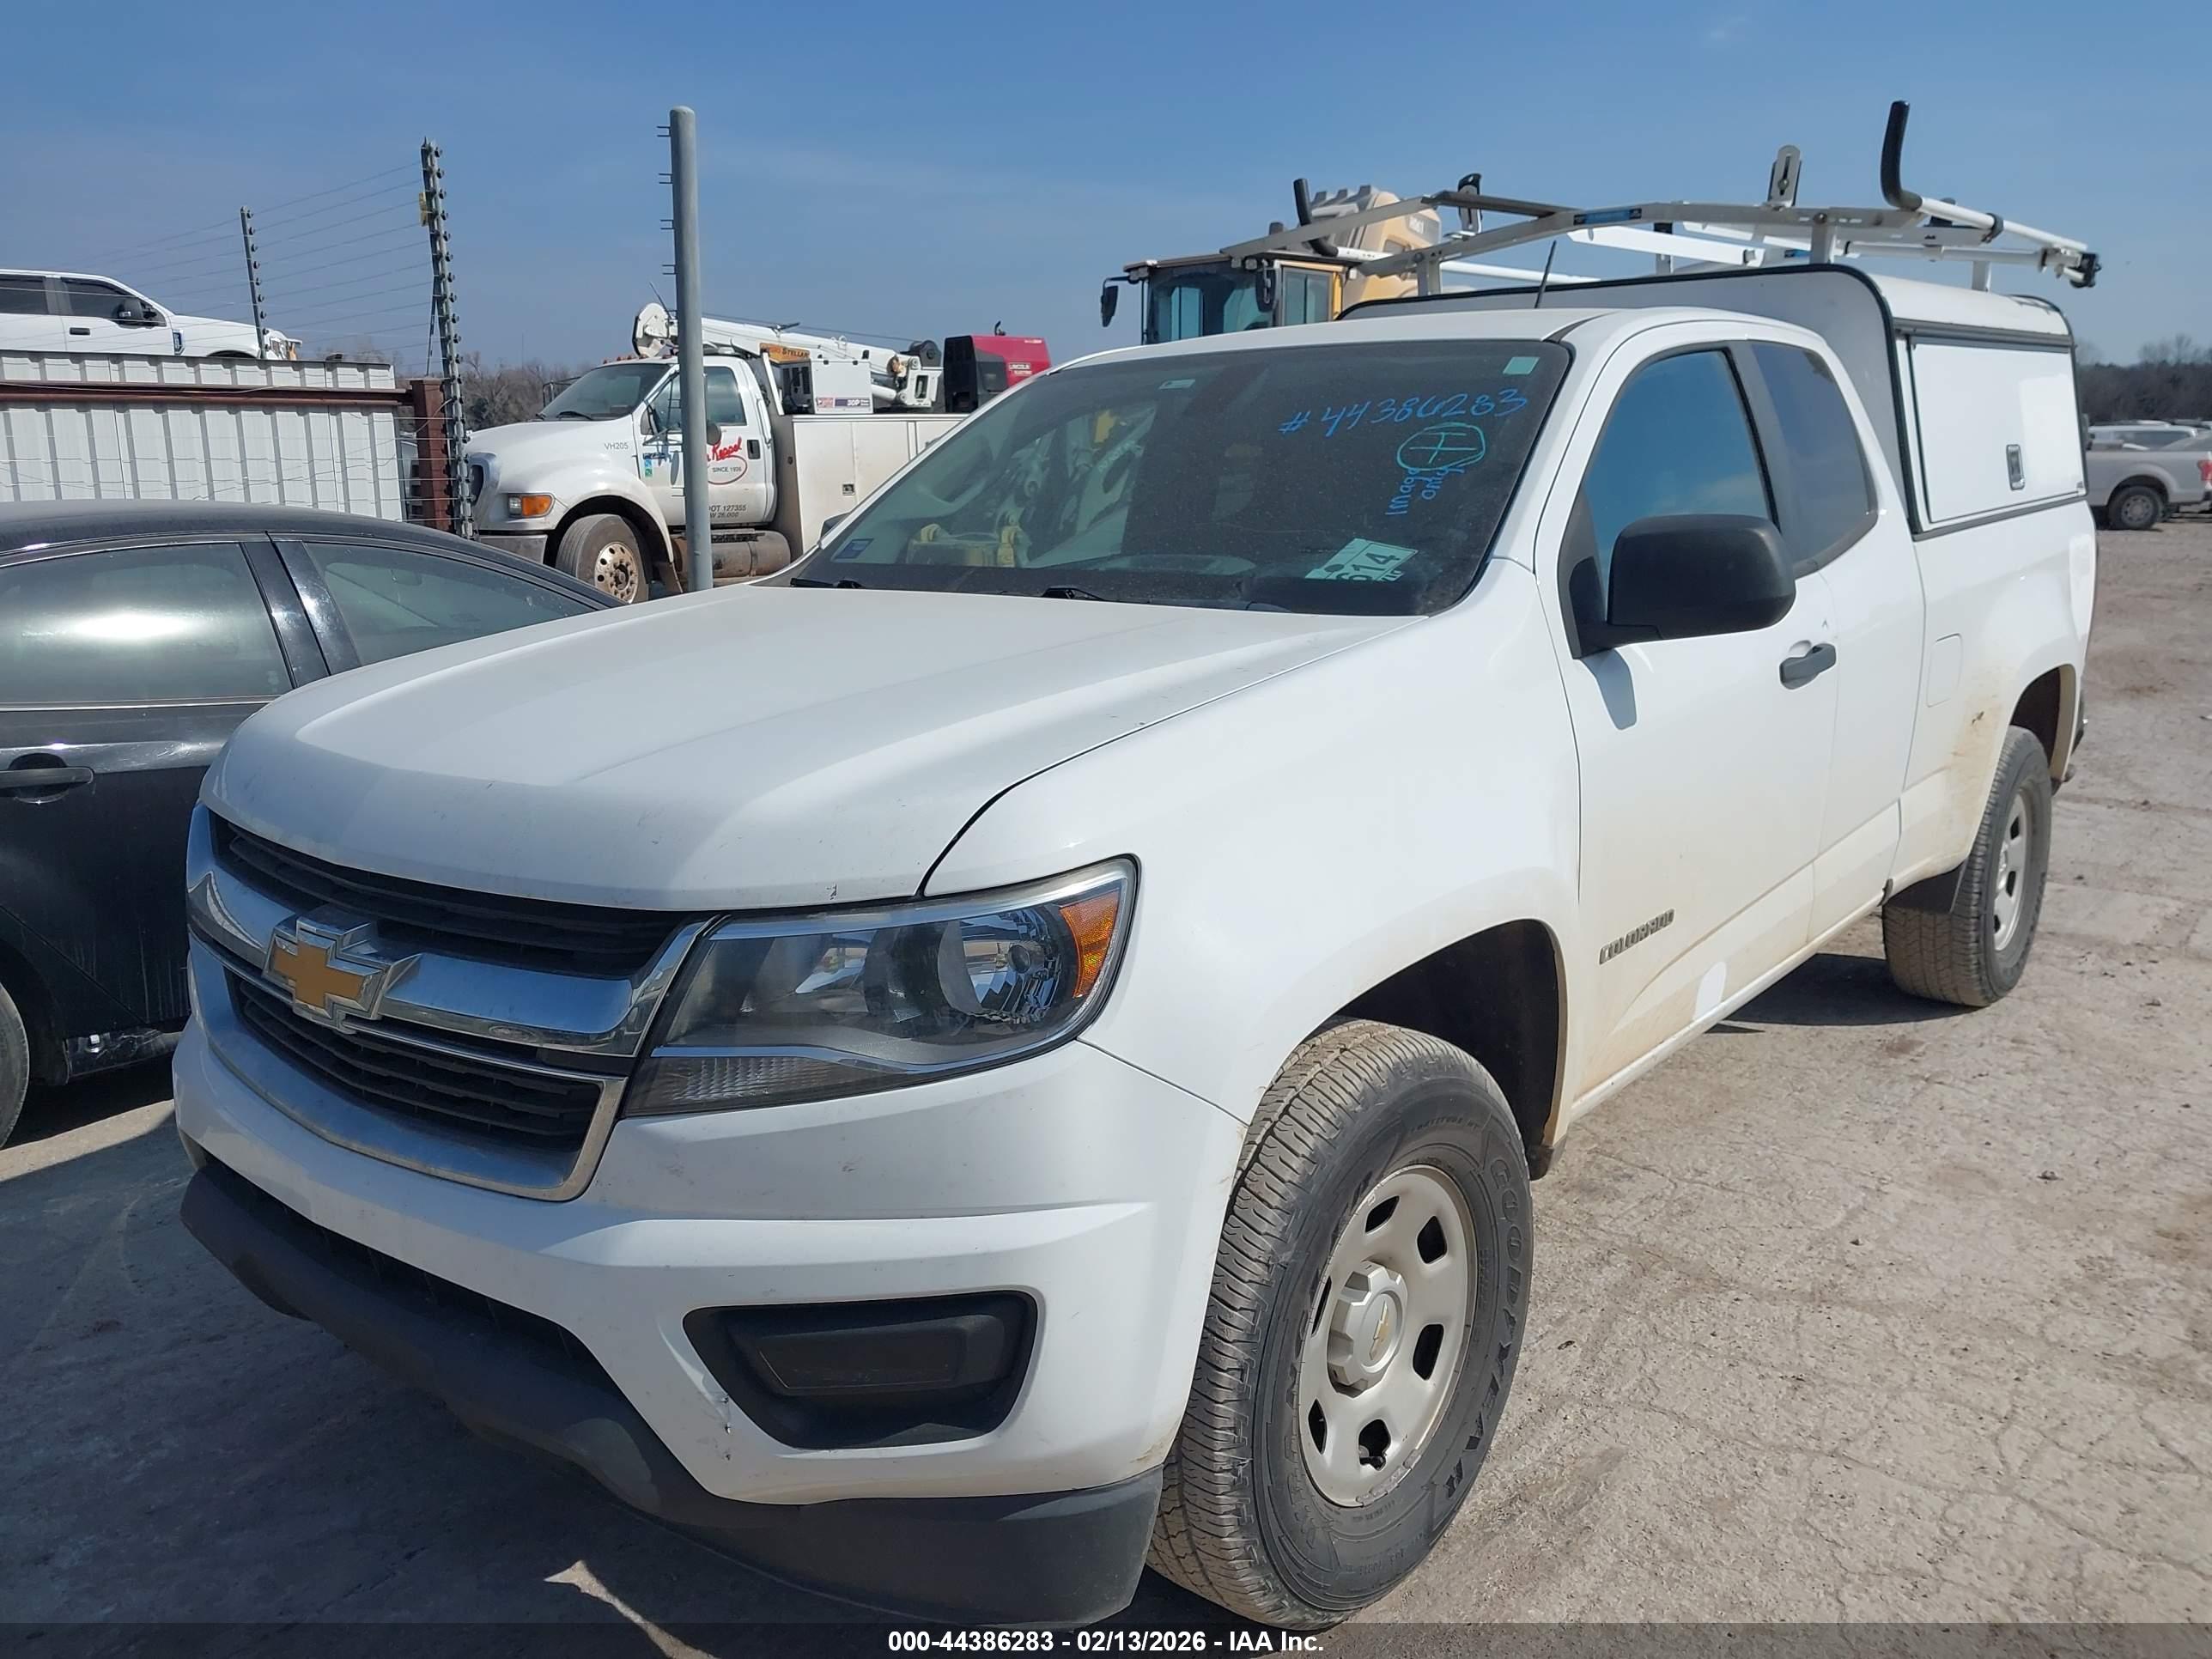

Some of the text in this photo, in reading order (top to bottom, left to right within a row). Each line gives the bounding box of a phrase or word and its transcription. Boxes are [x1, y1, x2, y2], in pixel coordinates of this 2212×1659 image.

[604, 441, 629, 450] VH205
[1599, 908, 1675, 965] COLORADO
[1444, 1157, 1523, 1500] GOODYEAR
